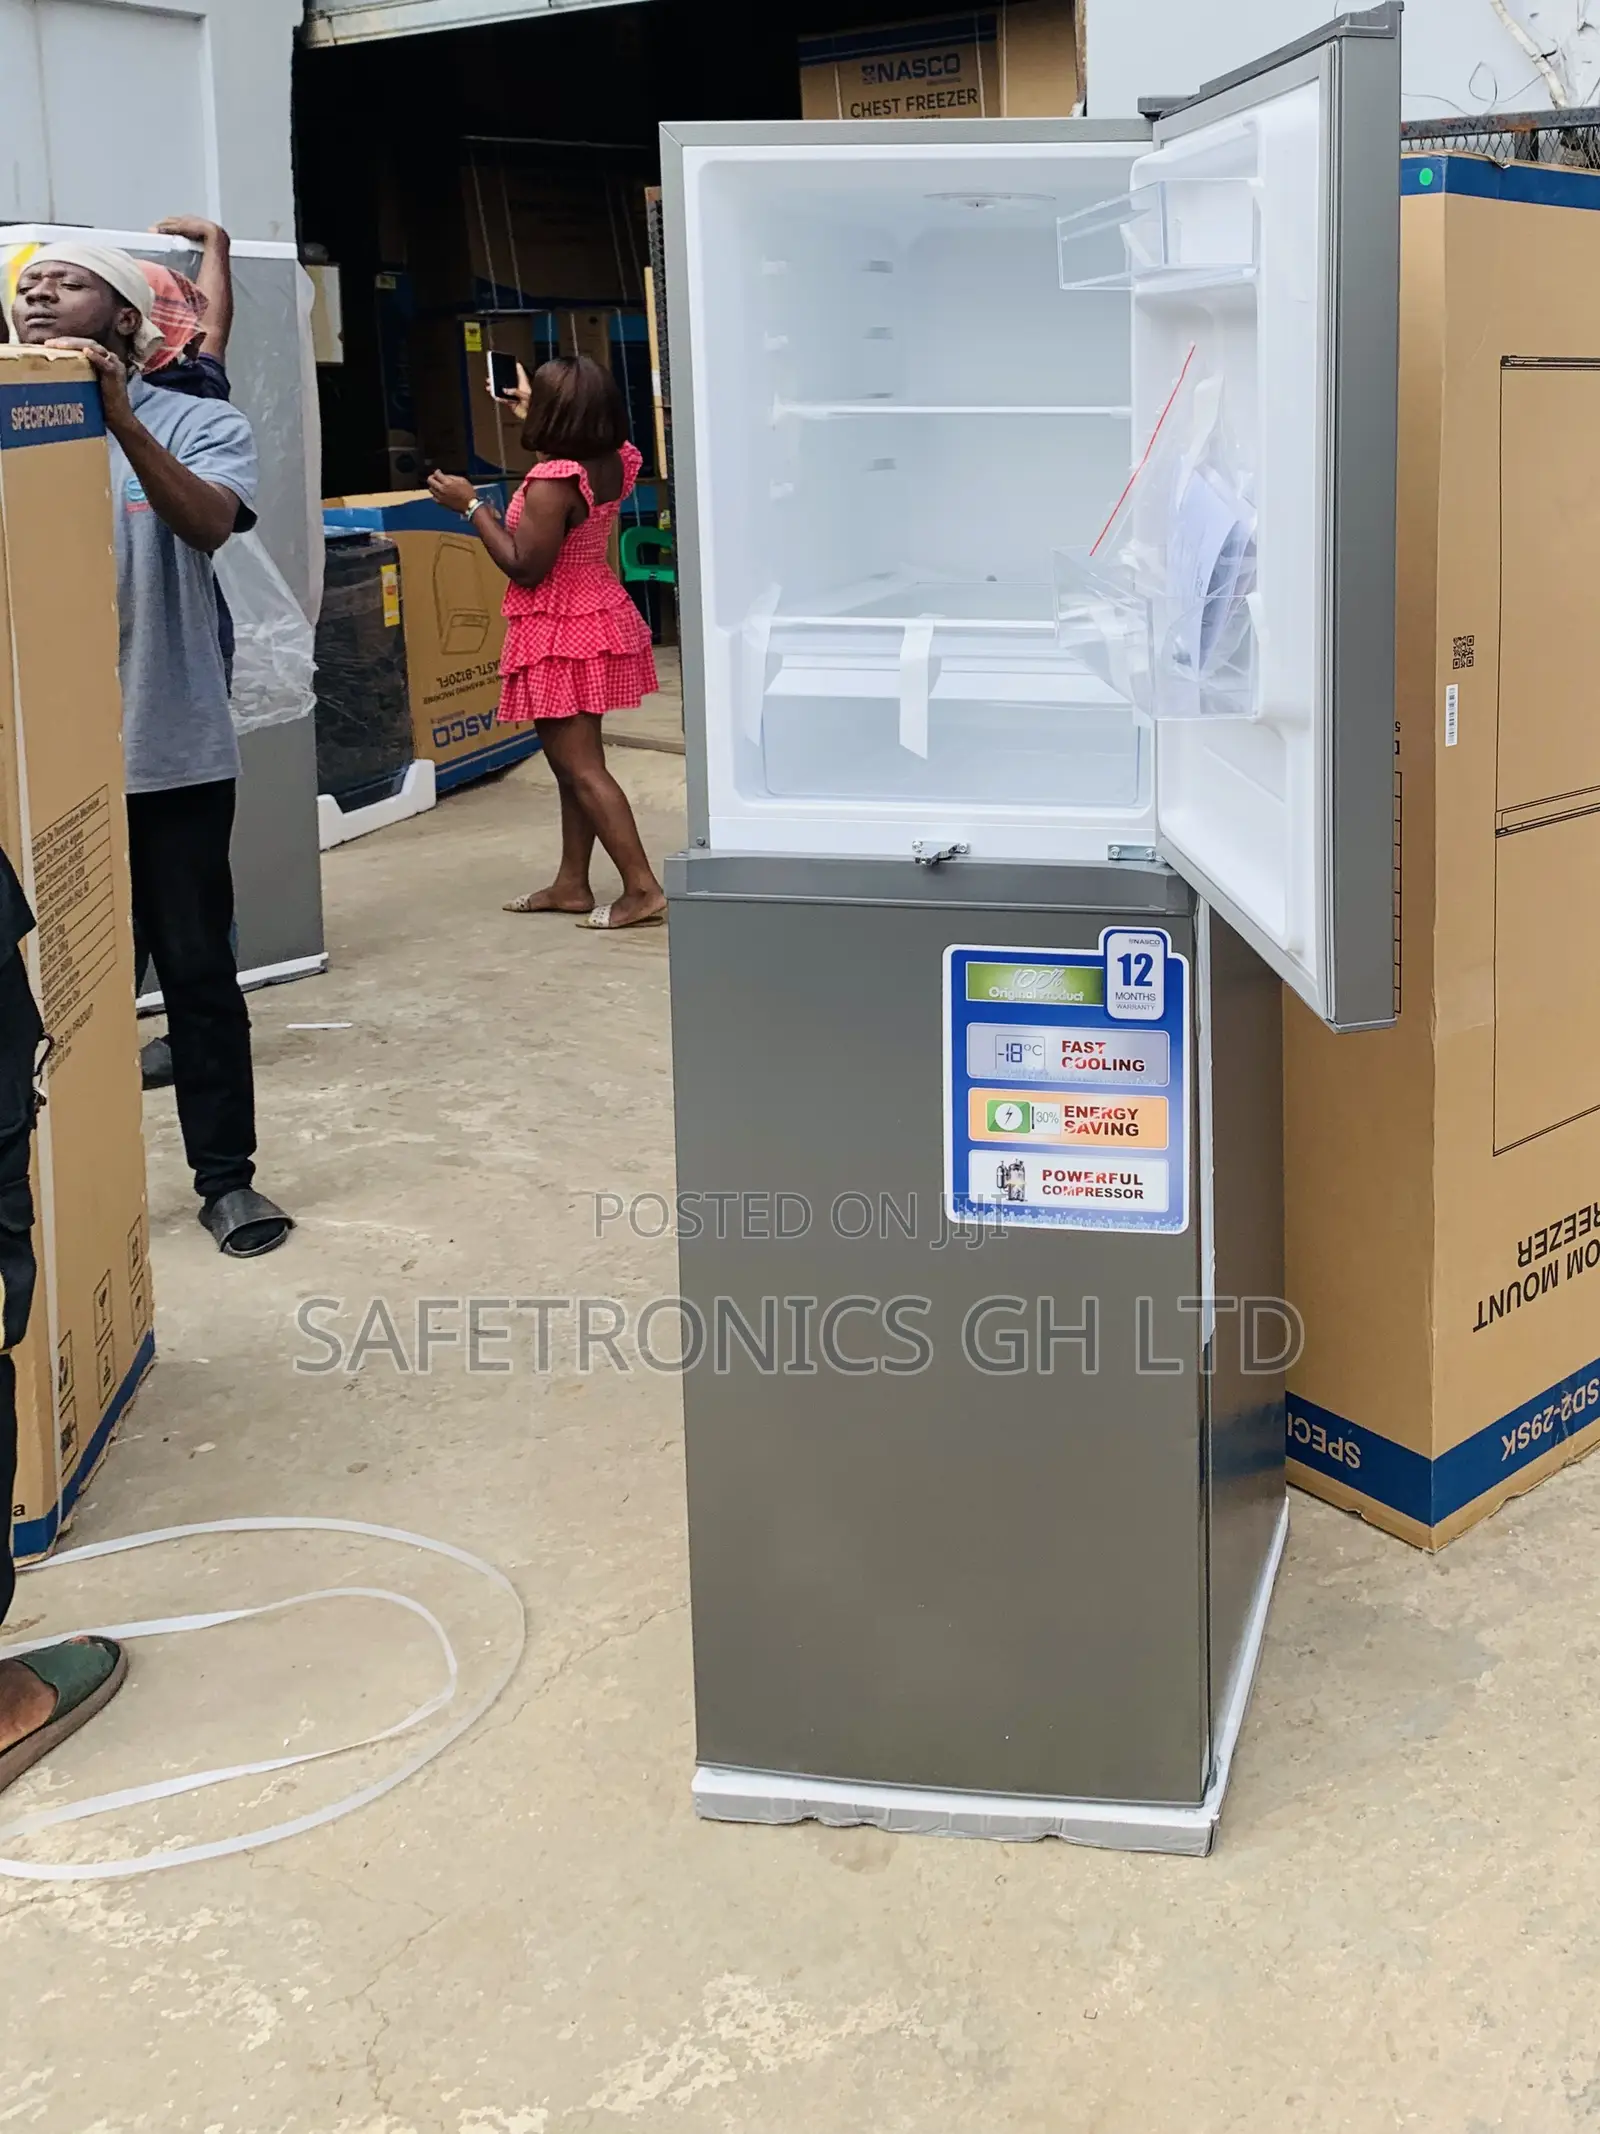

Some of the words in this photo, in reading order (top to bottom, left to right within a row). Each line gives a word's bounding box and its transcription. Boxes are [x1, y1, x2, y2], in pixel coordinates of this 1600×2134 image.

[877, 53, 960, 84] NASCO
[850, 98, 900, 118] CHEST
[906, 88, 978, 112] FREEZER
[11, 400, 84, 431] SPÉCIFICATIONS
[1117, 952, 1154, 987] 12
[988, 986, 1037, 1001] Original
[1040, 988, 1085, 1002] Product
[1115, 991, 1156, 1002] MONTHS
[1116, 1003, 1156, 1011] WARRANTY
[1061, 1040, 1107, 1054] FAST
[1061, 1056, 1146, 1072] COOLING
[1036, 1111, 1060, 1125] 30%
[1064, 1105, 1140, 1121] ENERGY
[1064, 1120, 1140, 1137] SAVING
[1042, 1169, 1144, 1186] POWERFUL
[1042, 1184, 1144, 1199] COMPRESSOR
[1473, 1259, 1559, 1333] MOUNT
